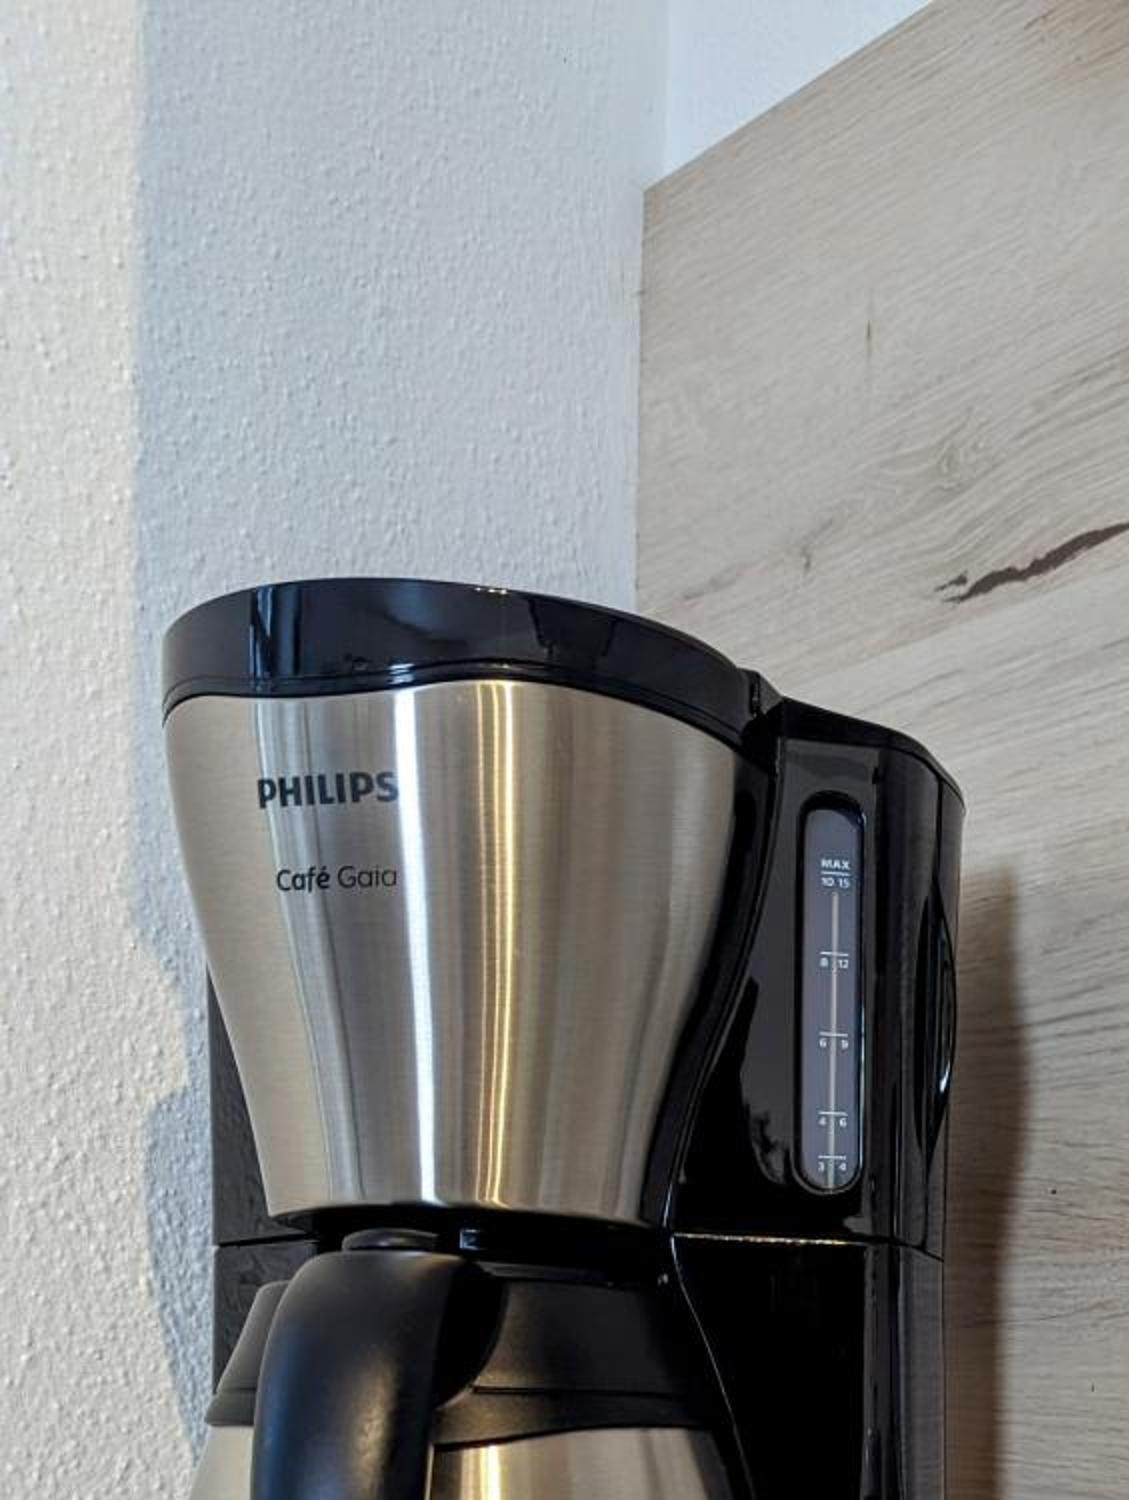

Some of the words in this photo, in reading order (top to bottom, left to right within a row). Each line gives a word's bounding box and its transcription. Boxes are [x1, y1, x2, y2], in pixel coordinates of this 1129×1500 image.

[257, 771, 400, 809] PHILIPS
[820, 858, 850, 870] MAX
[276, 866, 330, 893] Café
[337, 865, 397, 889] Gaia
[821, 877, 834, 887] 10
[838, 878, 850, 889] 15
[838, 959, 849, 969] 12
[819, 1038, 827, 1049] 6
[818, 1116, 827, 1126] 4
[839, 1117, 848, 1127] 6
[818, 1162, 825, 1172] 3
[838, 1162, 847, 1171] 4
